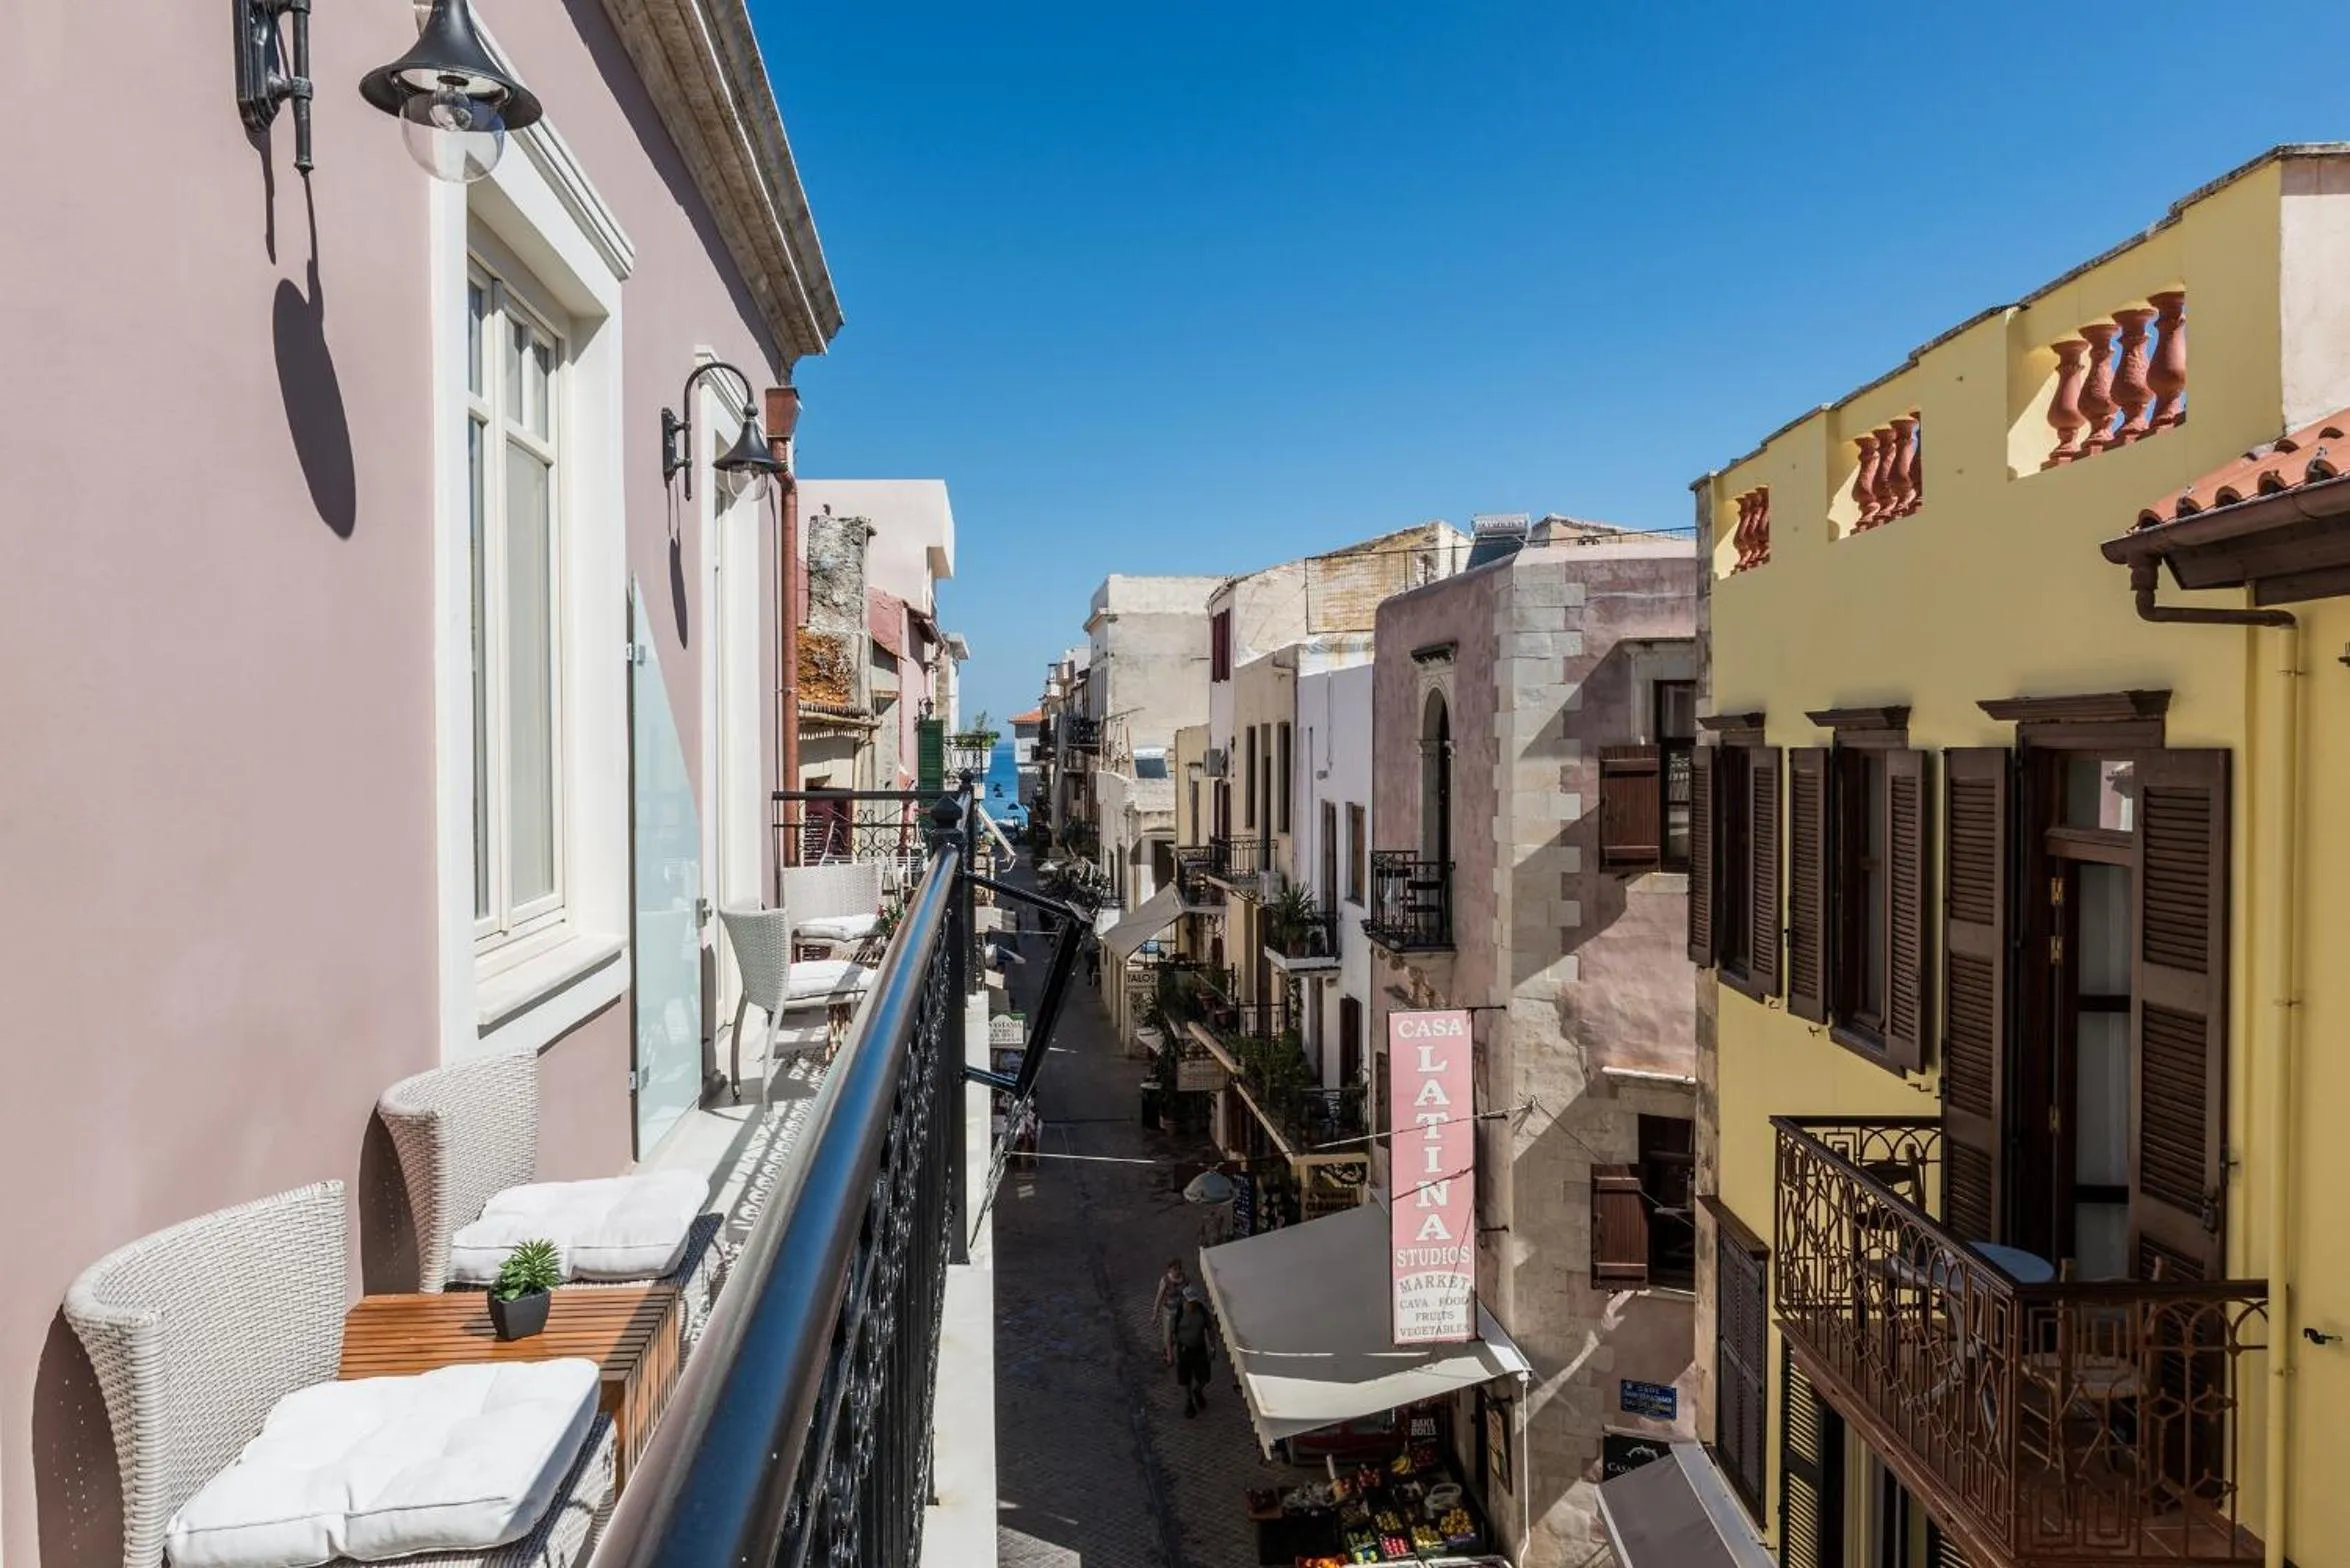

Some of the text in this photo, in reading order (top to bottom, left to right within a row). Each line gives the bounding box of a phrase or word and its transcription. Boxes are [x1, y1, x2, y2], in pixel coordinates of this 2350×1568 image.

[1398, 1018, 1463, 1038] CASA
[1414, 1045, 1451, 1241] LATINA
[1397, 1246, 1470, 1267] STUDIOS
[1400, 1274, 1470, 1293] MARKET
[1400, 1299, 1429, 1310] CAVA
[1416, 1310, 1455, 1322] FRUITS
[1400, 1324, 1470, 1337] VEGETABLES
